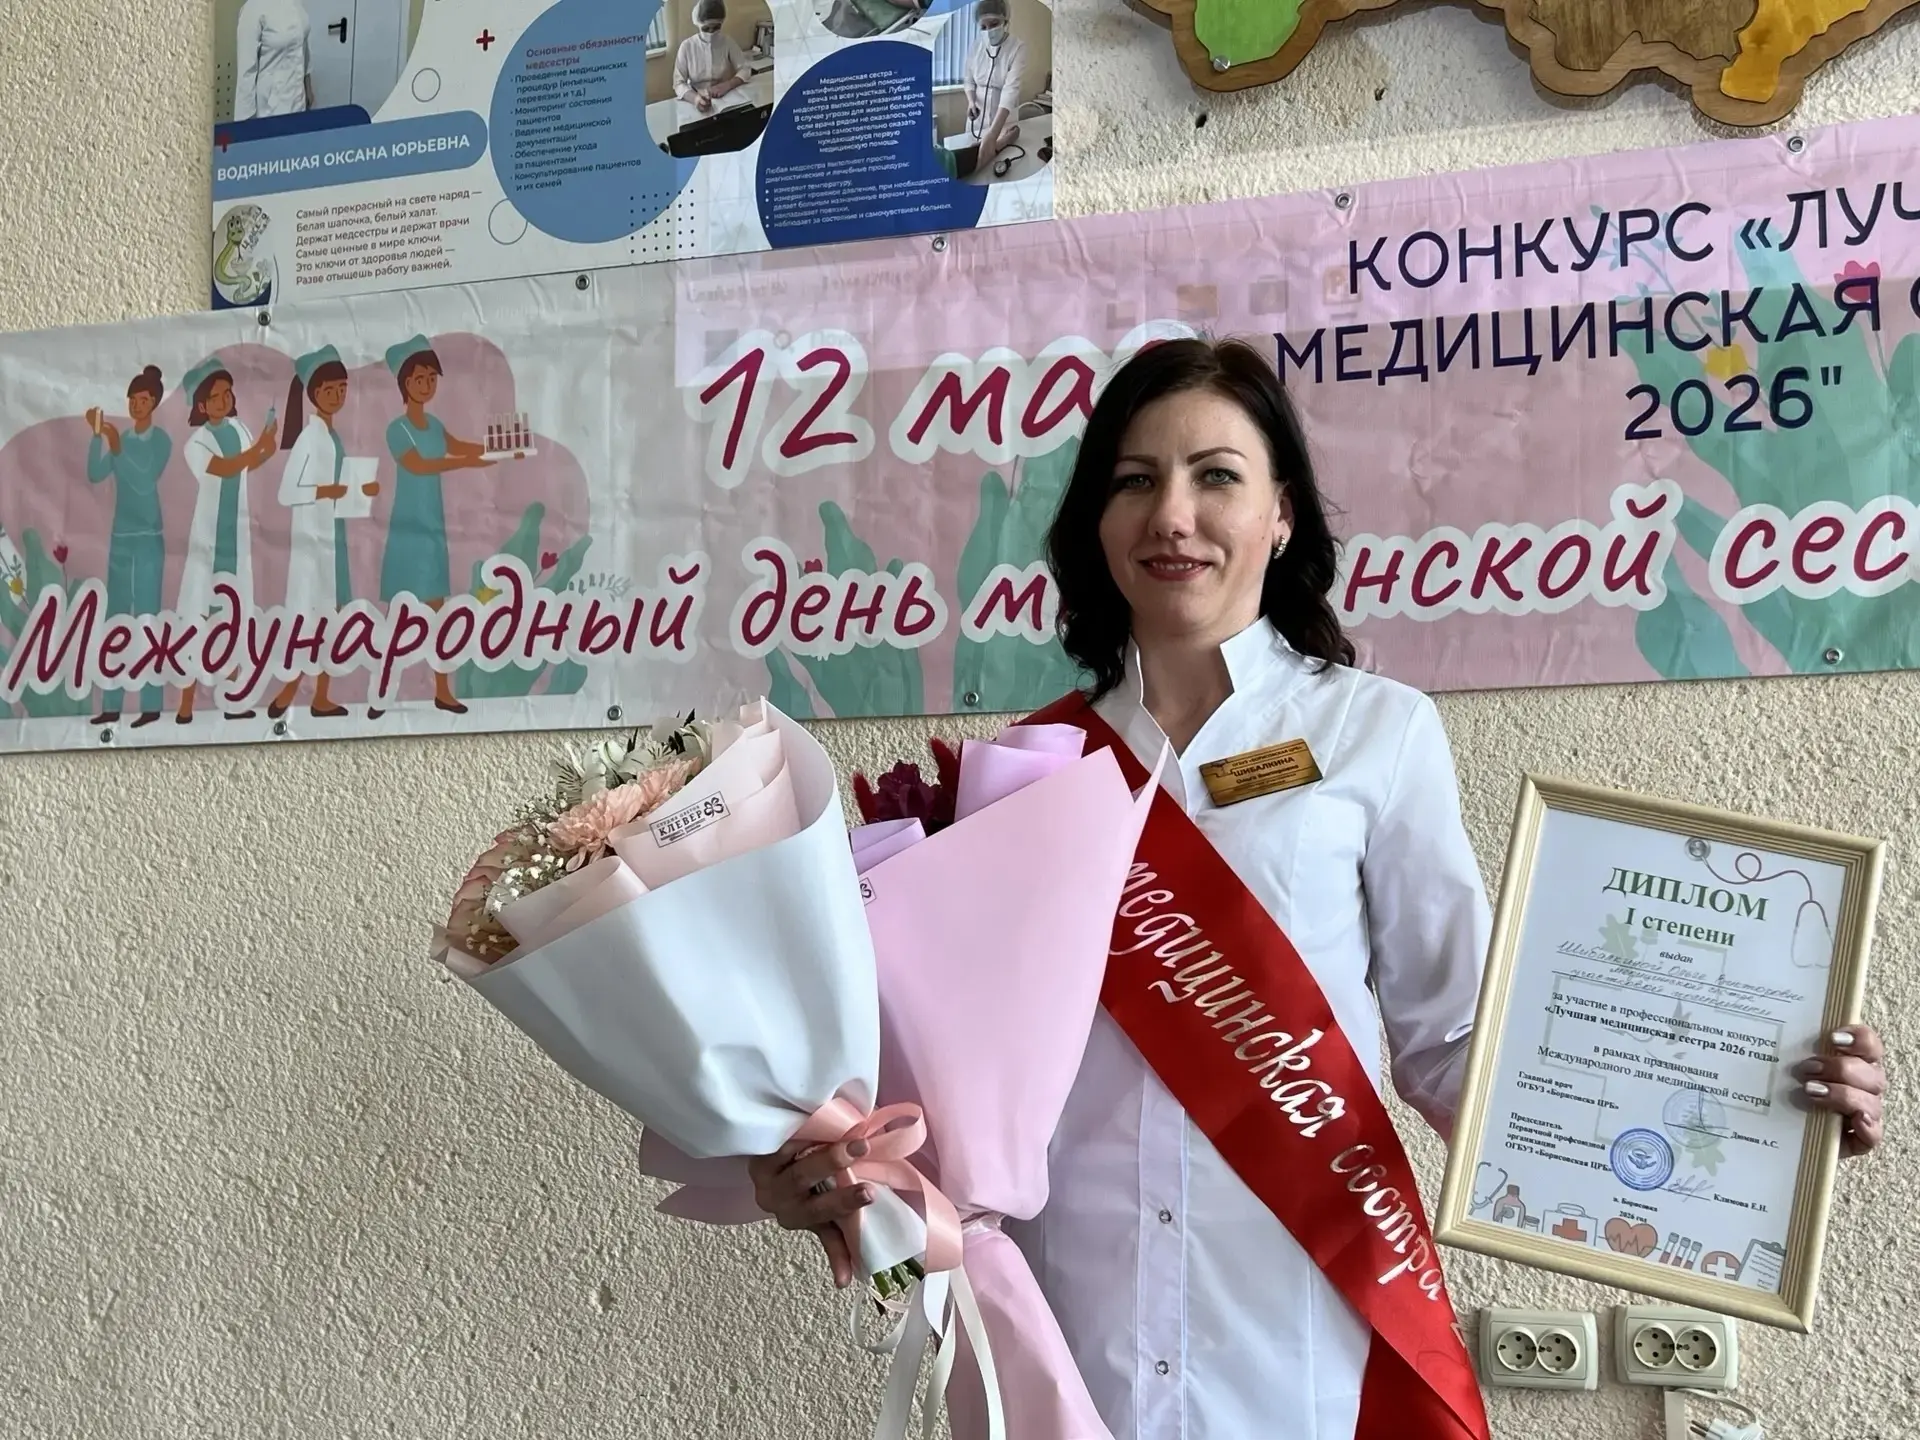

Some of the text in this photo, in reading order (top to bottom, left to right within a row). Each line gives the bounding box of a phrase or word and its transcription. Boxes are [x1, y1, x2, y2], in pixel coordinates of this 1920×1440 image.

[526, 35, 644, 58] Основные обязанности
[515, 62, 628, 83] Проведение медицинских
[525, 56, 580, 70] медсестры
[516, 82, 558, 94] процедур
[820, 70, 892, 85] Медицинская сестра
[514, 96, 612, 115] Мониторинг состояния
[516, 114, 561, 126] пациентов
[217, 134, 470, 181] ВОДЯНИЦКАЯ ОКСАНА ЮРЬЕВНА
[573, 142, 598, 153] ухода
[595, 159, 642, 171] пациентов
[535, 178, 562, 189] семей
[296, 190, 470, 219] Самый прекрасный на свете наряд
[295, 234, 333, 247] Держат
[335, 228, 389, 240] медсестры
[400, 221, 437, 234] держат
[439, 217, 470, 229] врачи
[296, 208, 438, 233] Белая шапочка, белый халат.
[295, 234, 442, 259] Самые ценные в мире ключи.
[295, 245, 443, 272] Это ключи от здоровья людей
[1349, 202, 1714, 295] КОНКУРС
[296, 258, 452, 286] Разве отыщешь работу важней.
[1273, 276, 1880, 386] МЕДИЦИНСКАЯ
[700, 340, 1168, 470] 12 ма
[8, 563, 700, 702] Международный
[741, 549, 936, 646] день
[1233, 756, 1295, 777] ШИБАЛКИНА
[658, 809, 702, 837] КЛЕВЕР
[1602, 866, 1769, 921] ДИПЛОМ
[1624, 907, 1735, 947] I степени
[1556, 940, 1664, 971] Шибалкиной
[1659, 951, 1693, 964] выдан
[1552, 991, 1777, 1049] за участие в профессиональном конкурсе
[1544, 1004, 1780, 1063] «Лучшая медицинская сестра 2026 года»
[1593, 1044, 1719, 1080] в рамках празднования
[1518, 1070, 1573, 1090] Главный врач
[1537, 1045, 1771, 1107] Международного дня медицинской сестры
[1516, 1080, 1545, 1093] ОГБУЗ
[1597, 1099, 1619, 1110] ЦРБ»
[1510, 1111, 1563, 1130] Председатель
[1506, 1132, 1556, 1149] организации
[1508, 1121, 1606, 1151] Первичной профсоюзной
[1761, 1138, 1779, 1149] А.С.
[1505, 1140, 1534, 1154] ОГБУЗ
[1534, 1148, 1589, 1167] «Борисовская
[1619, 1210, 1635, 1220] 2026
[1621, 1197, 1658, 1212] Борисовка
[1713, 1193, 1768, 1213] Климова Е.Н.
[1330, 1144, 1444, 1301] сестра
